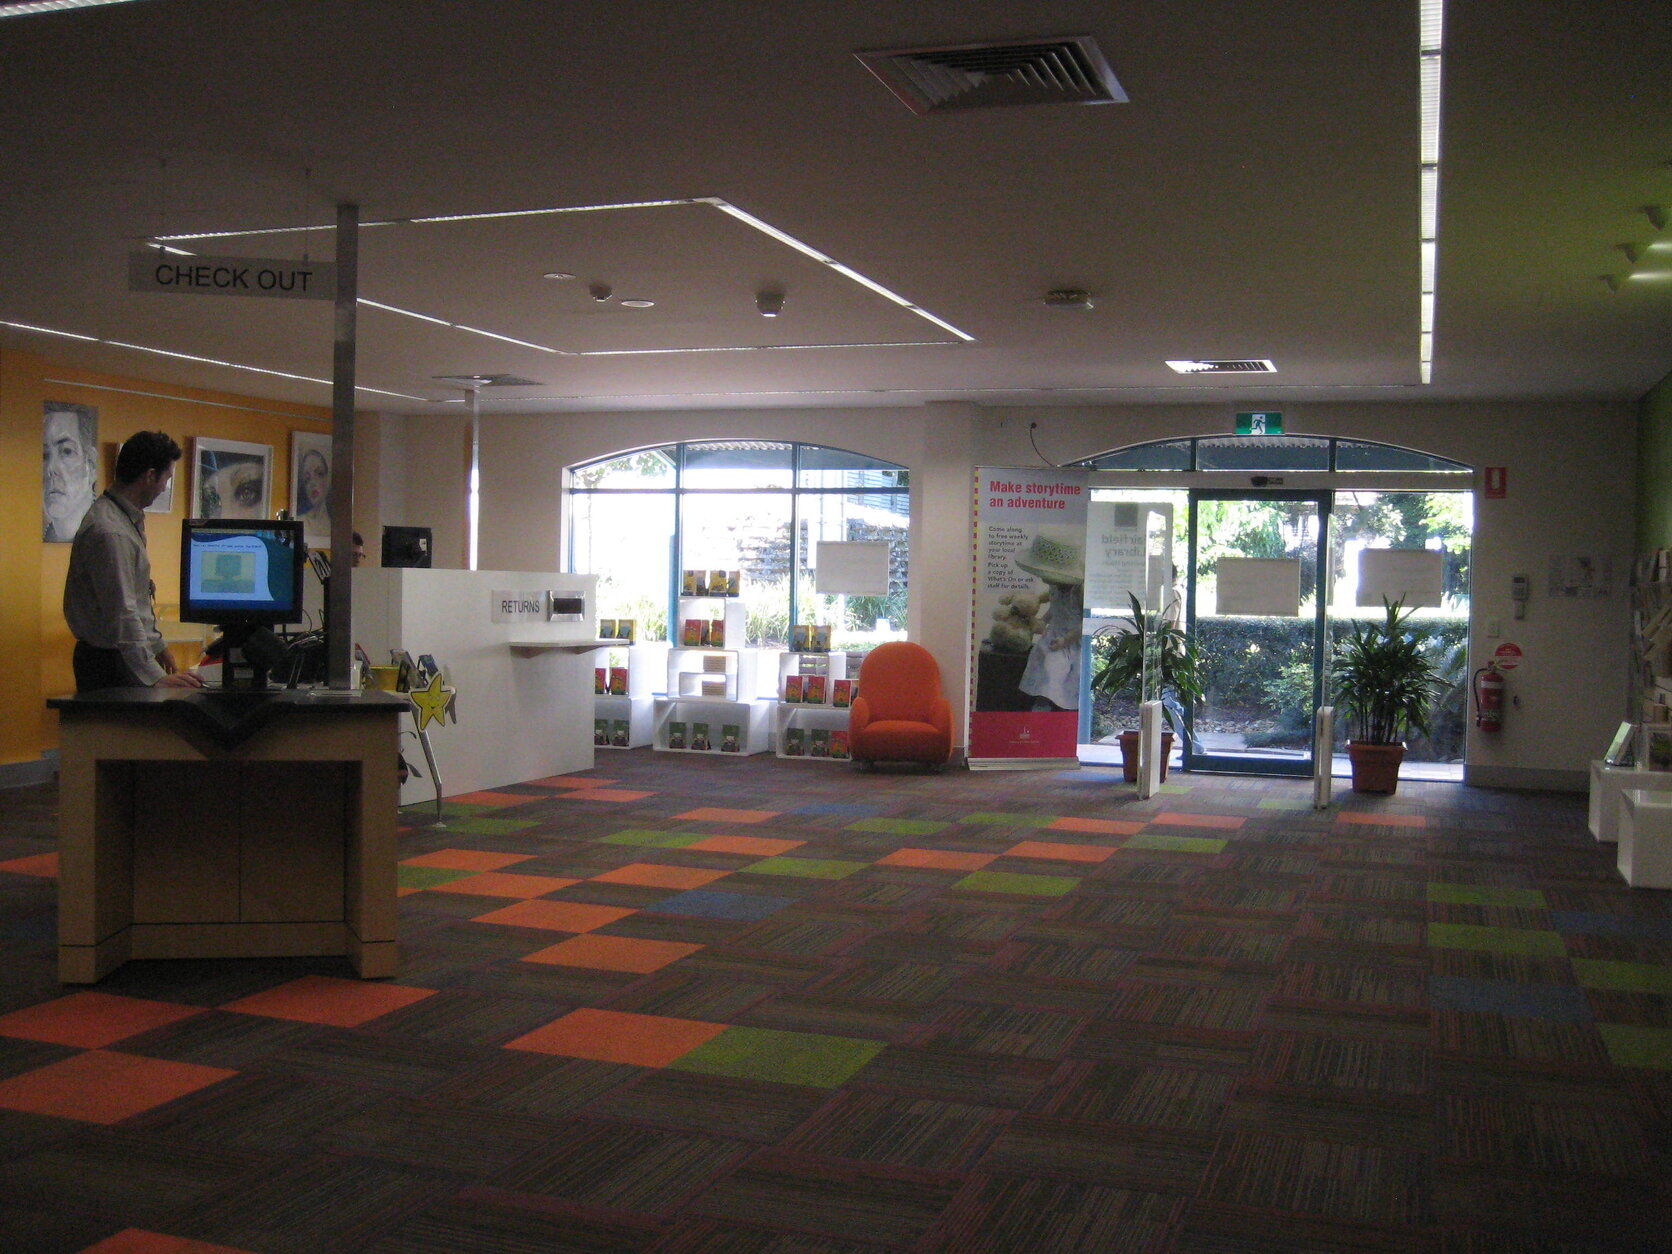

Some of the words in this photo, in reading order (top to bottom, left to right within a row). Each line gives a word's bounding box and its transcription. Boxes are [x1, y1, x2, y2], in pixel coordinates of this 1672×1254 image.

[156, 264, 249, 289] CHECK
[258, 269, 313, 292] OUT
[990, 481, 1022, 493] Make
[1026, 482, 1080, 496] storytime
[990, 497, 1003, 507] an
[1008, 496, 1065, 509] adventure
[501, 600, 540, 613] RETURNS
